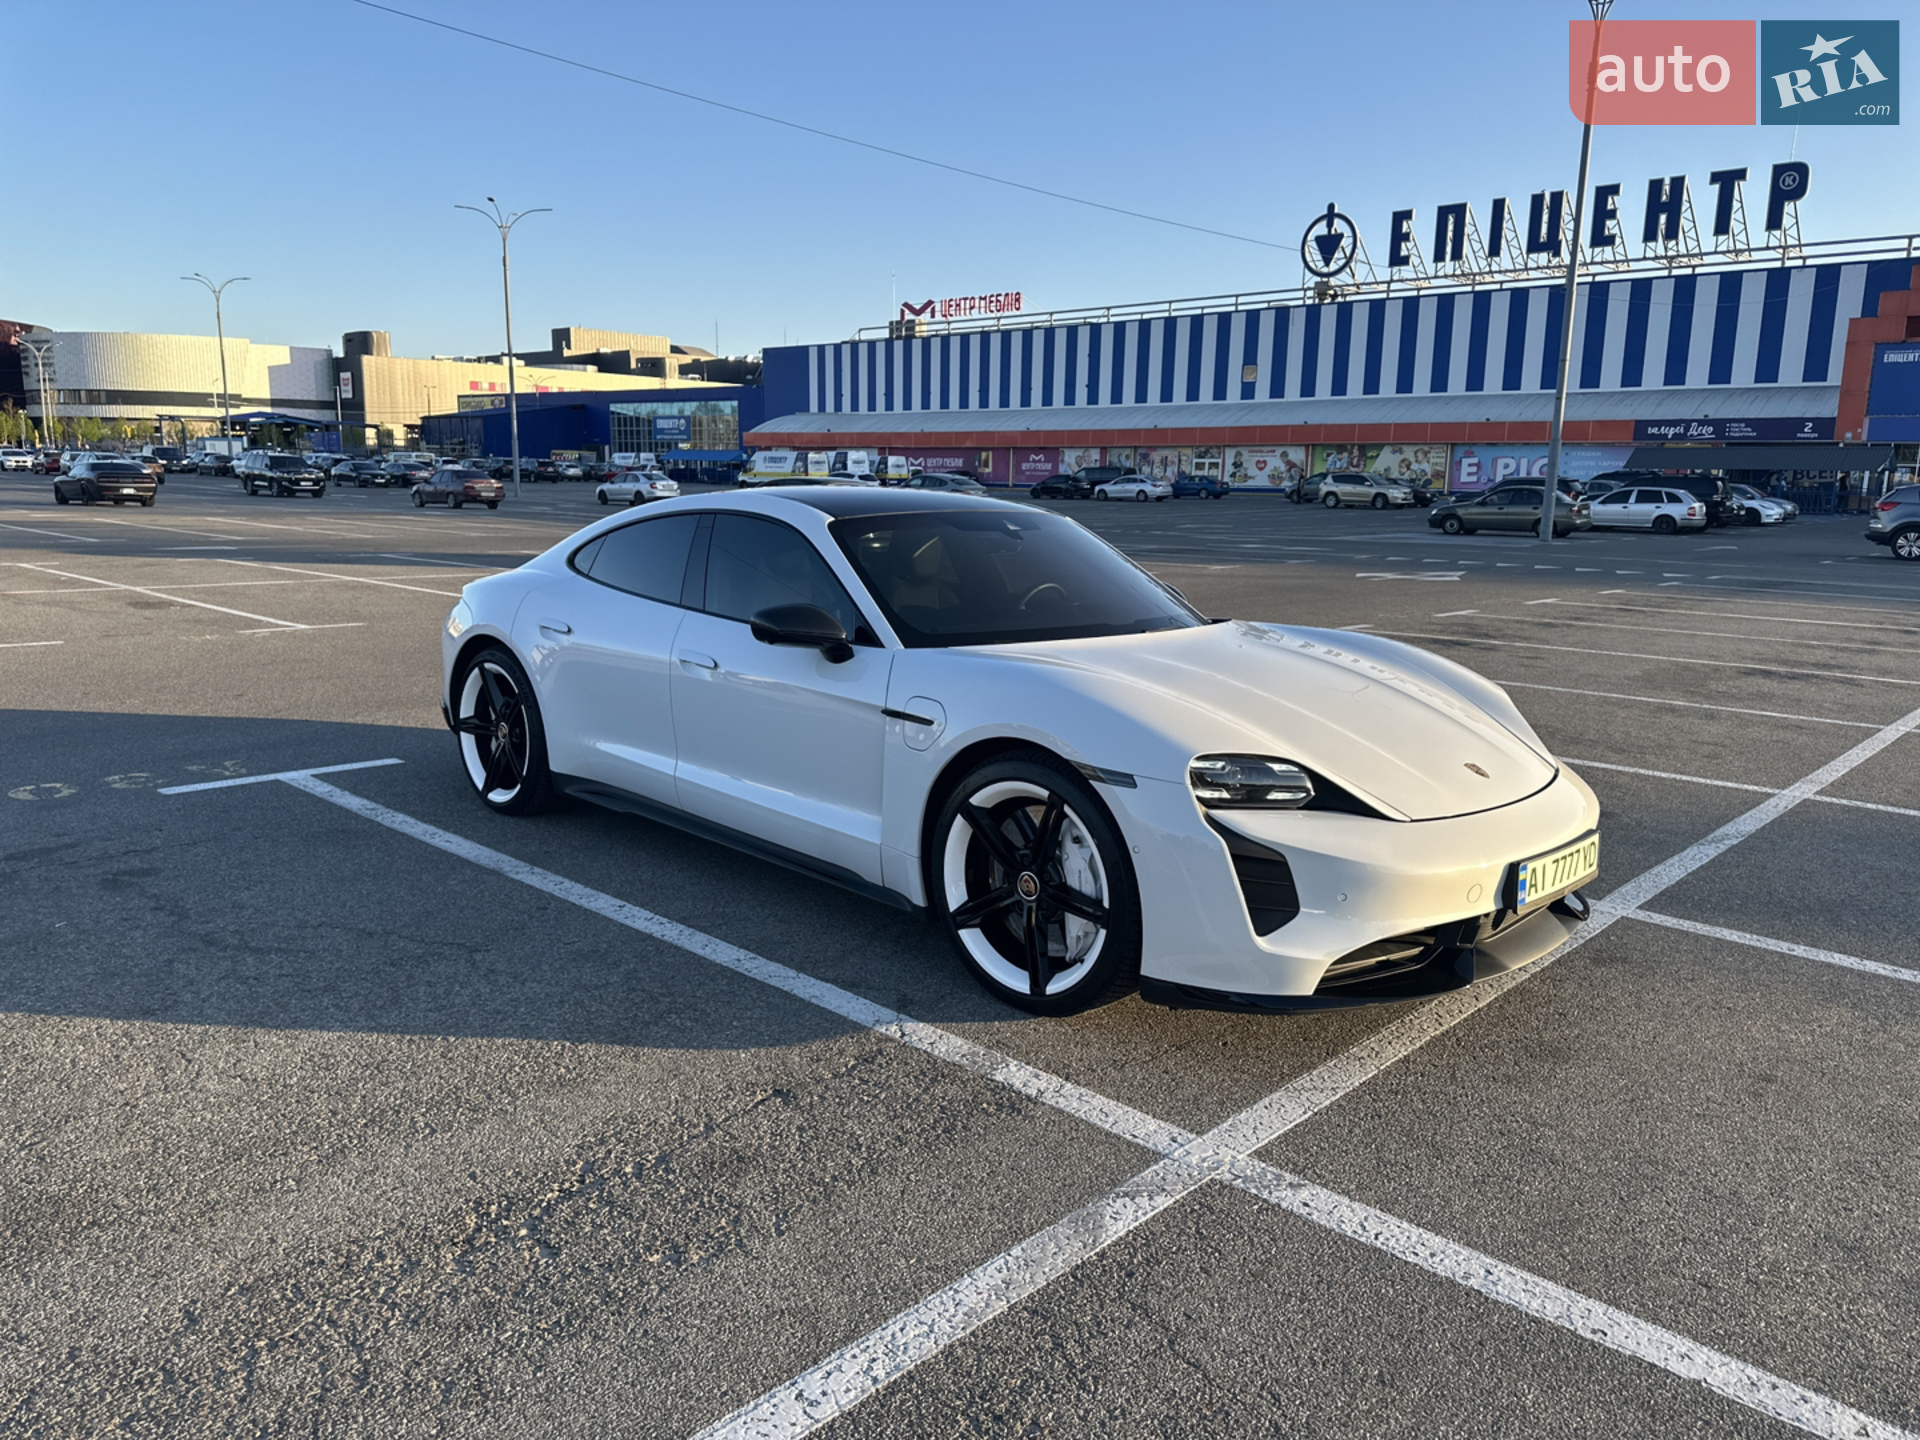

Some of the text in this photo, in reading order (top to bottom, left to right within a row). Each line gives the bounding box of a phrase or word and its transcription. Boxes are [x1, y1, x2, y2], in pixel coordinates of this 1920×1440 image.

[1388, 161, 1811, 269] ЕПІЦЕНТР
[940, 291, 1022, 320] ЦЕНТР МЕБЛІВ
[1884, 353, 1920, 363] ЕПІЦЕНТ
[1687, 422, 1716, 438] Деко
[1804, 422, 1813, 432] 2
[1552, 848, 1581, 887] 7777
